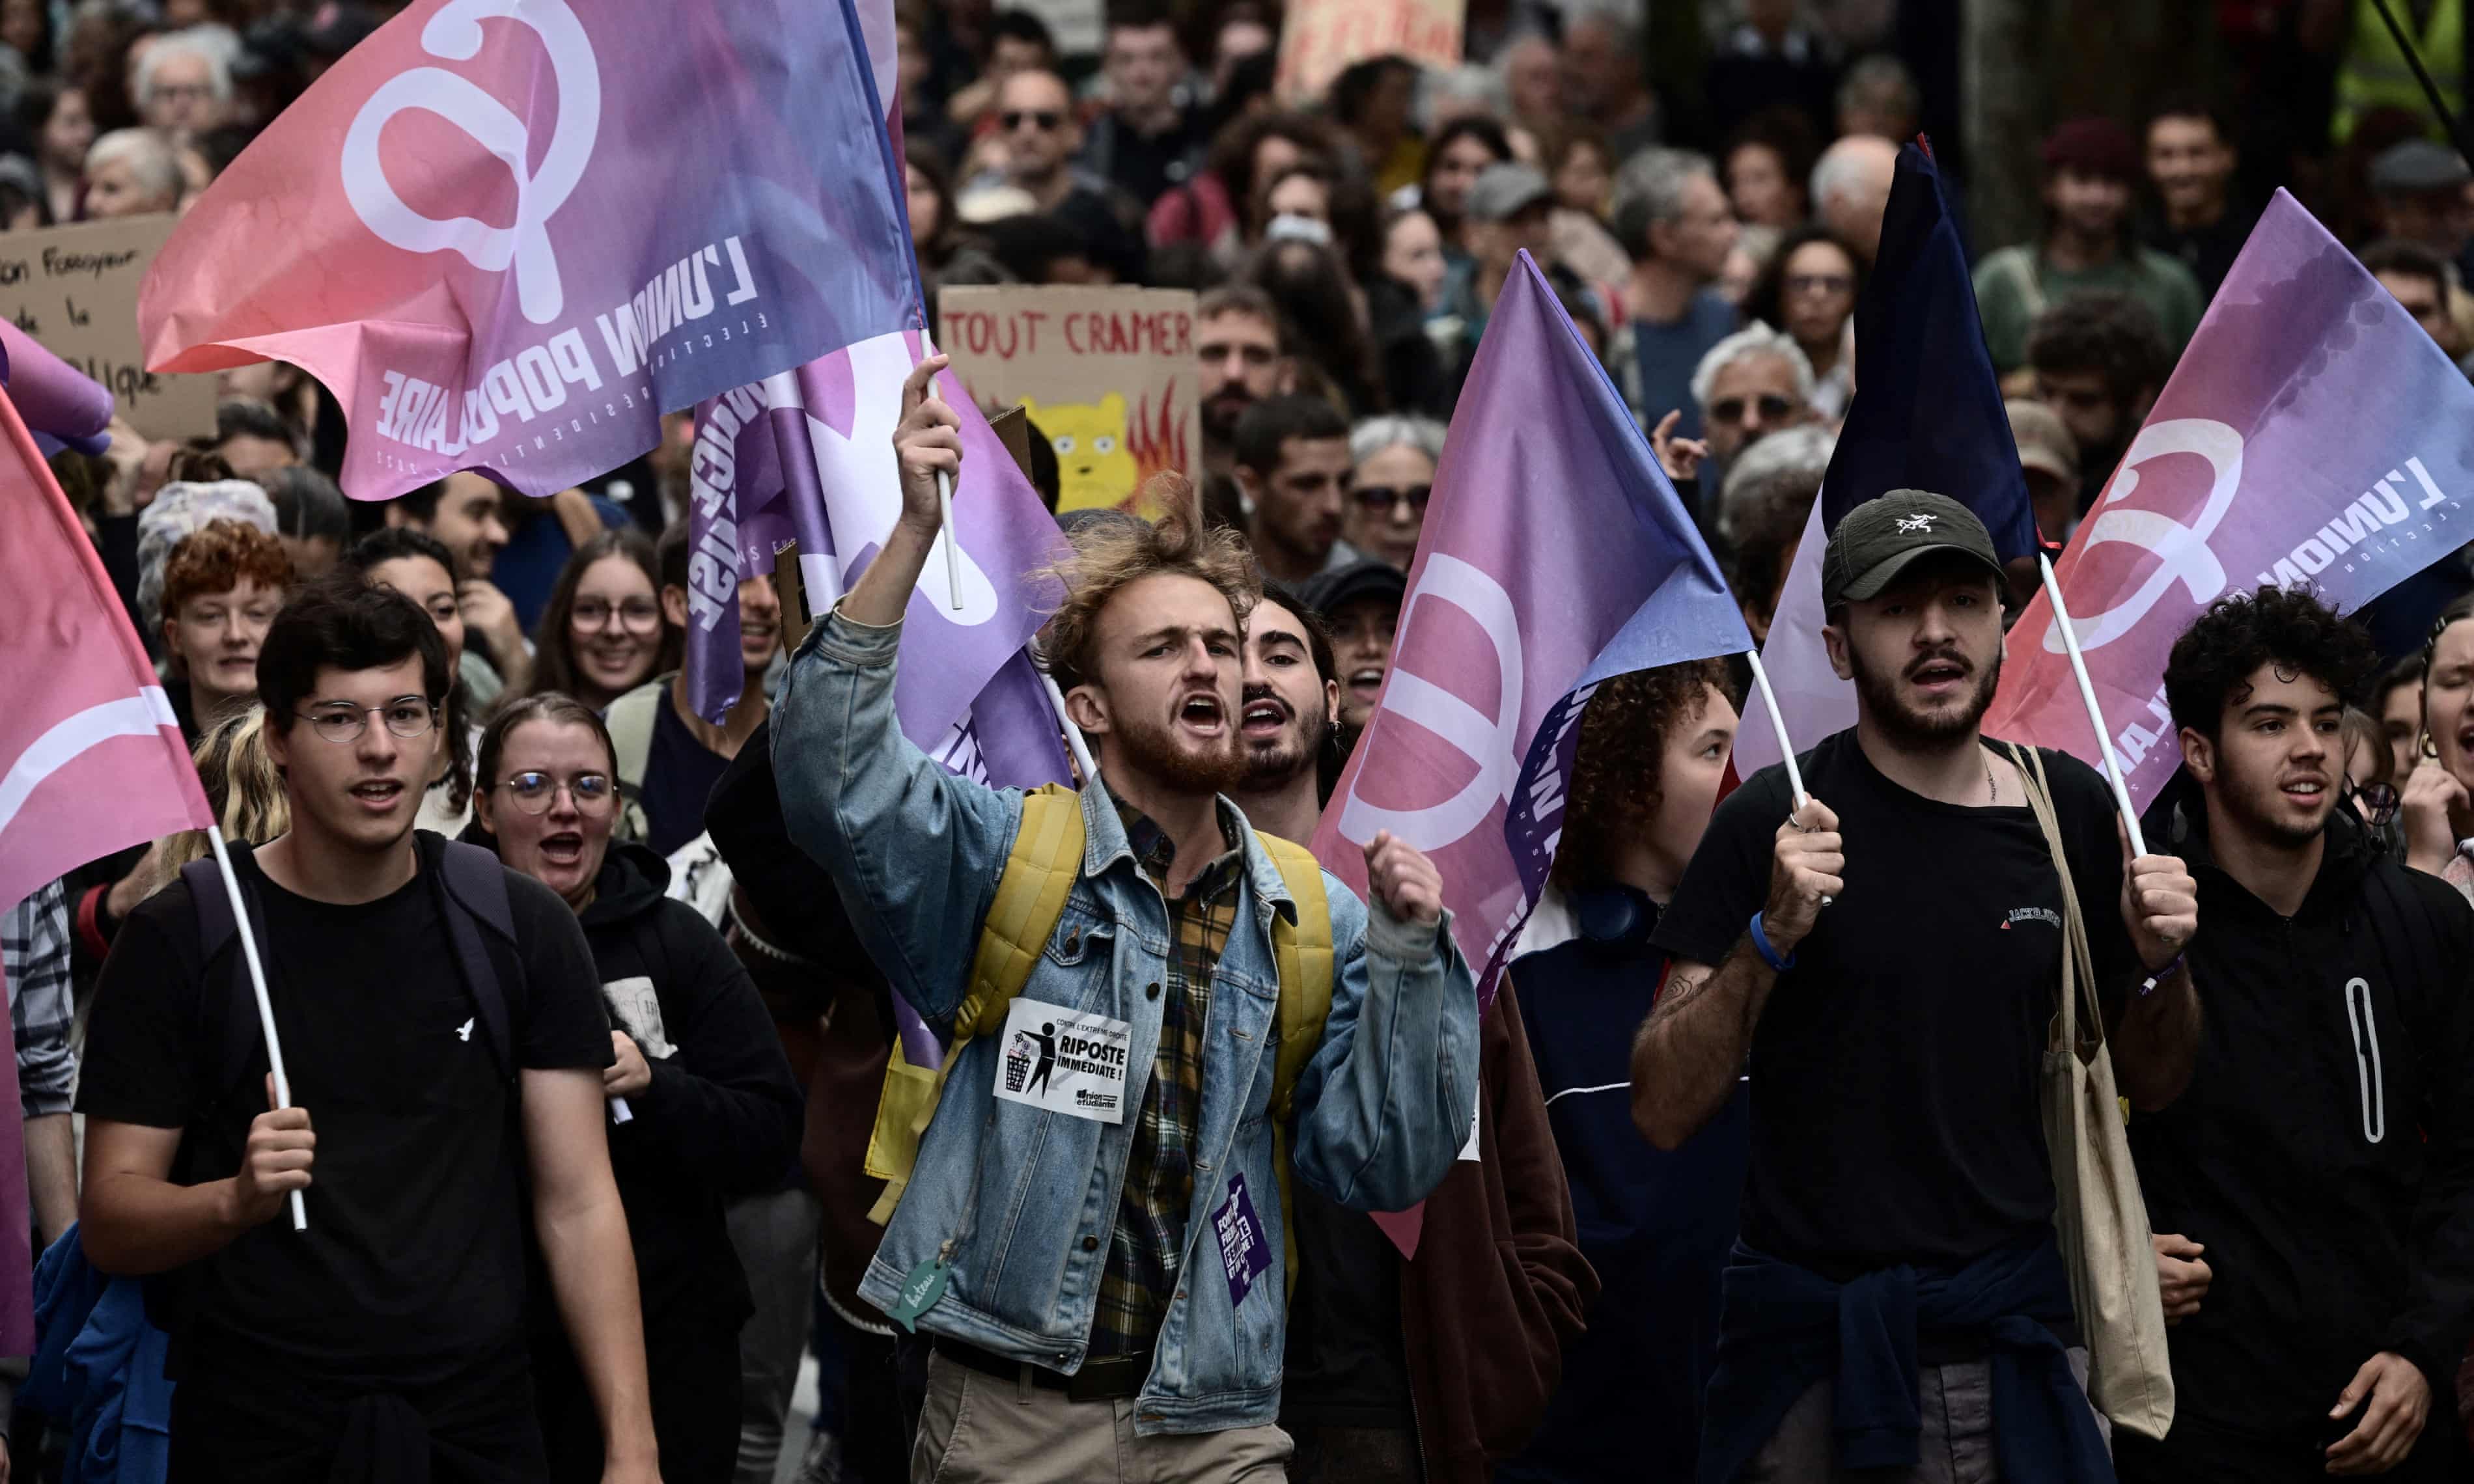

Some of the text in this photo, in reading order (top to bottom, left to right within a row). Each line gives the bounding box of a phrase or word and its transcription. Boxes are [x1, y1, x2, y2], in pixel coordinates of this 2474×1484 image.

[943, 309, 1193, 360] TOUT CRAMER
[1060, 1035, 1126, 1065] RIPOSTE
